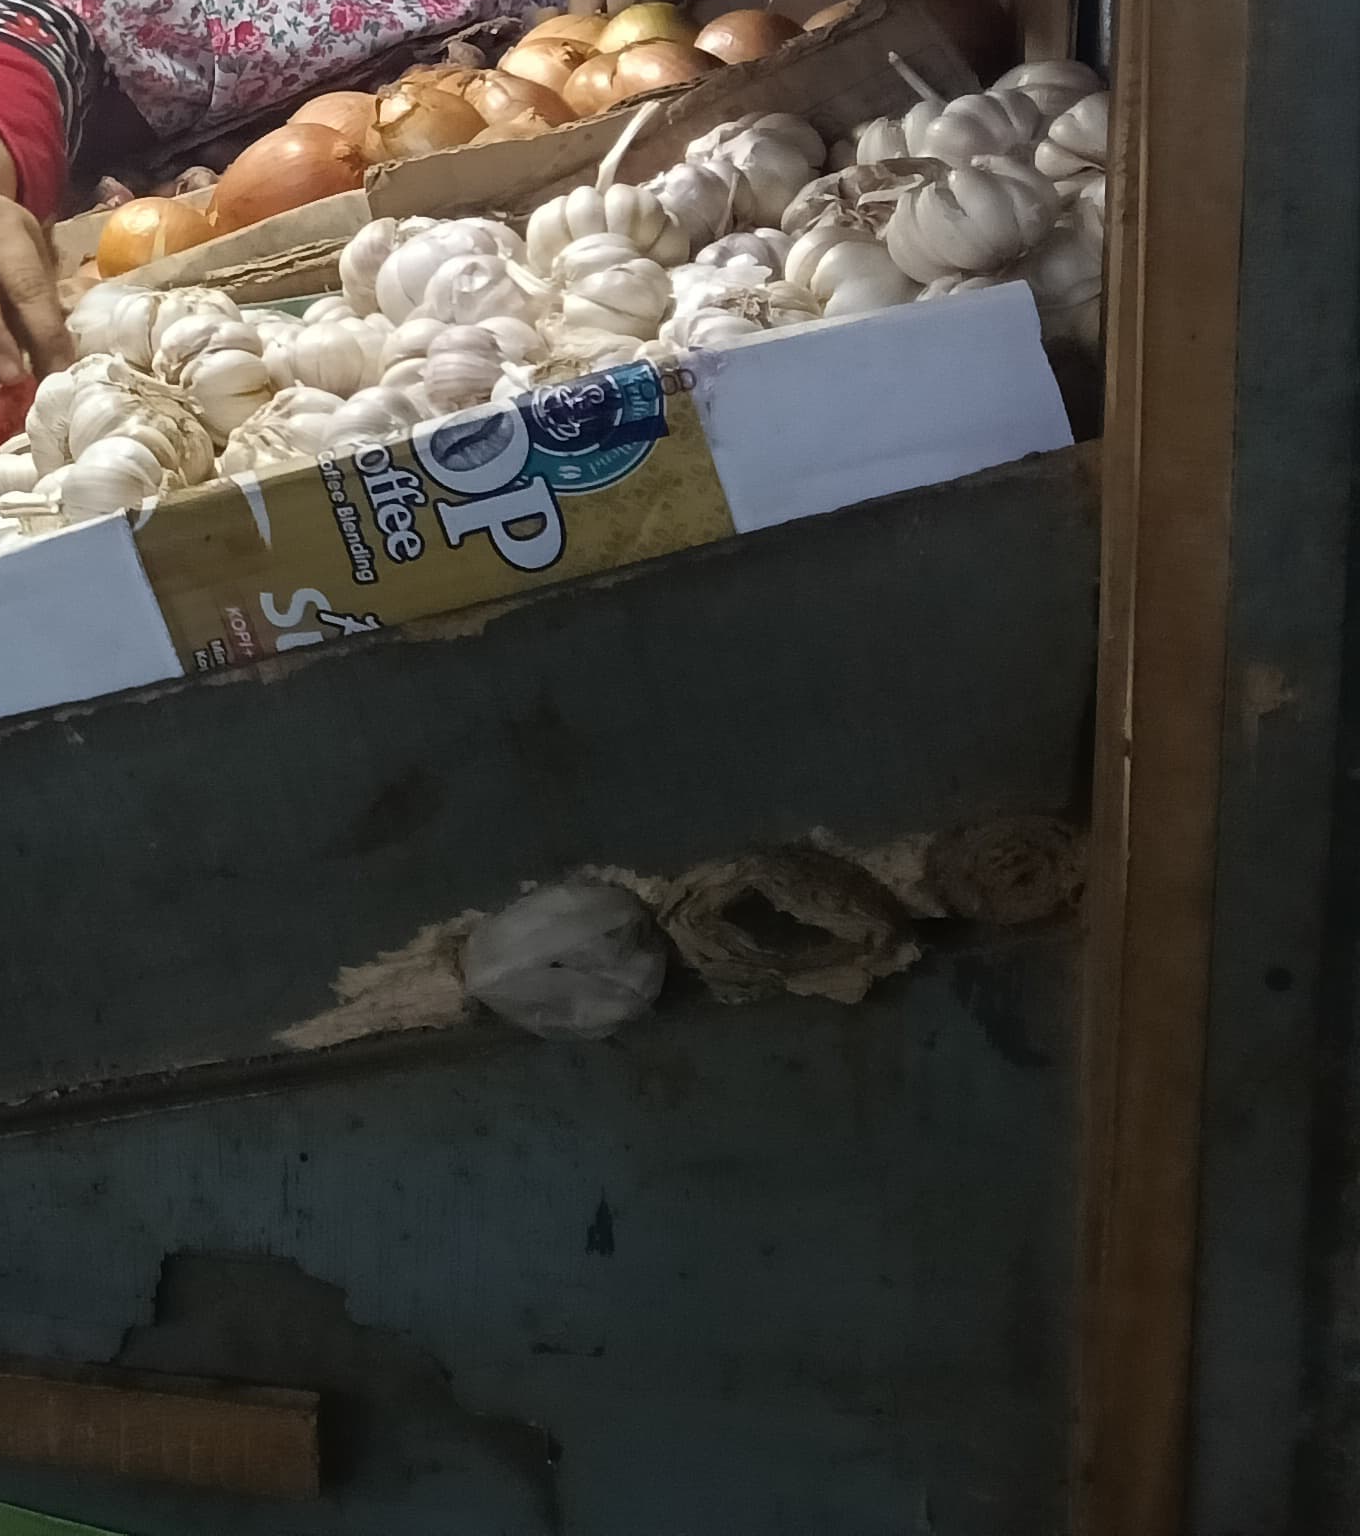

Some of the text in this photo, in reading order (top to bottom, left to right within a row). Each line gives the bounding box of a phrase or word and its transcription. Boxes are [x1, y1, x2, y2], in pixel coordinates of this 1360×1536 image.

[317, 450, 375, 583] Coffee Blending
[352, 440, 428, 563] offee
